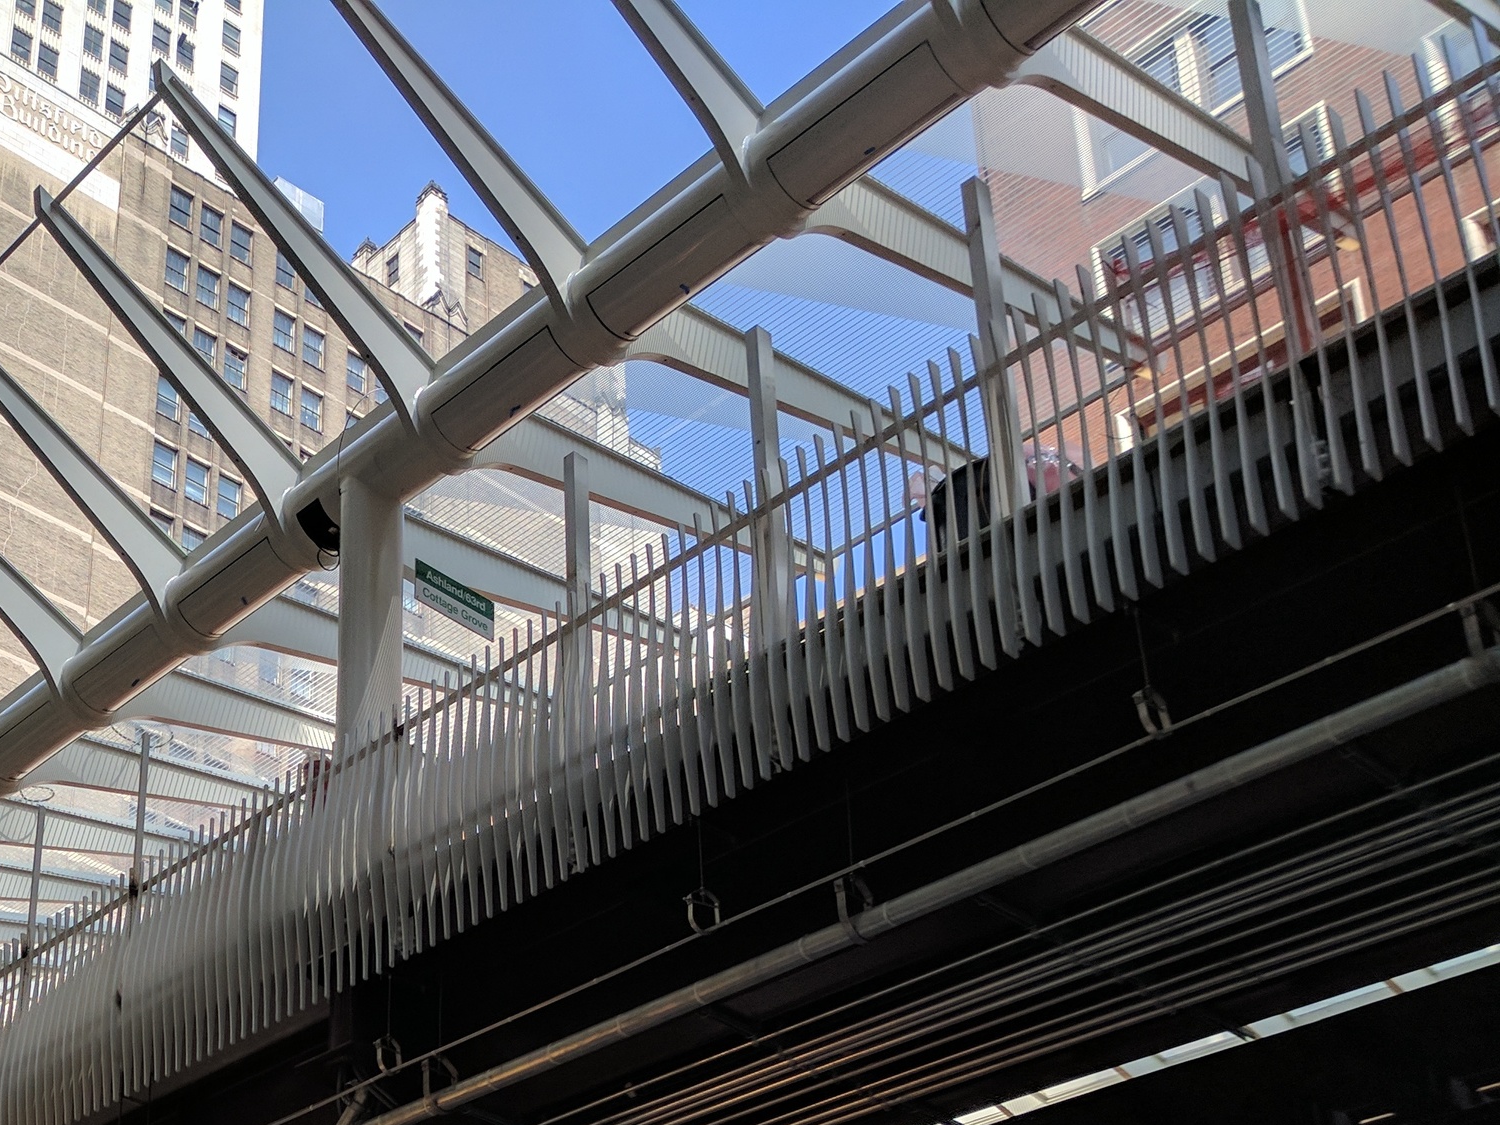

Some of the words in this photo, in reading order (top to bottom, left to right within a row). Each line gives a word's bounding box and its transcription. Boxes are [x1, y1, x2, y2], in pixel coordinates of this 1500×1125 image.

[422, 587, 459, 615] Cottage
[461, 608, 489, 632] Grove
[426, 570, 486, 612] Ashland/63rd
